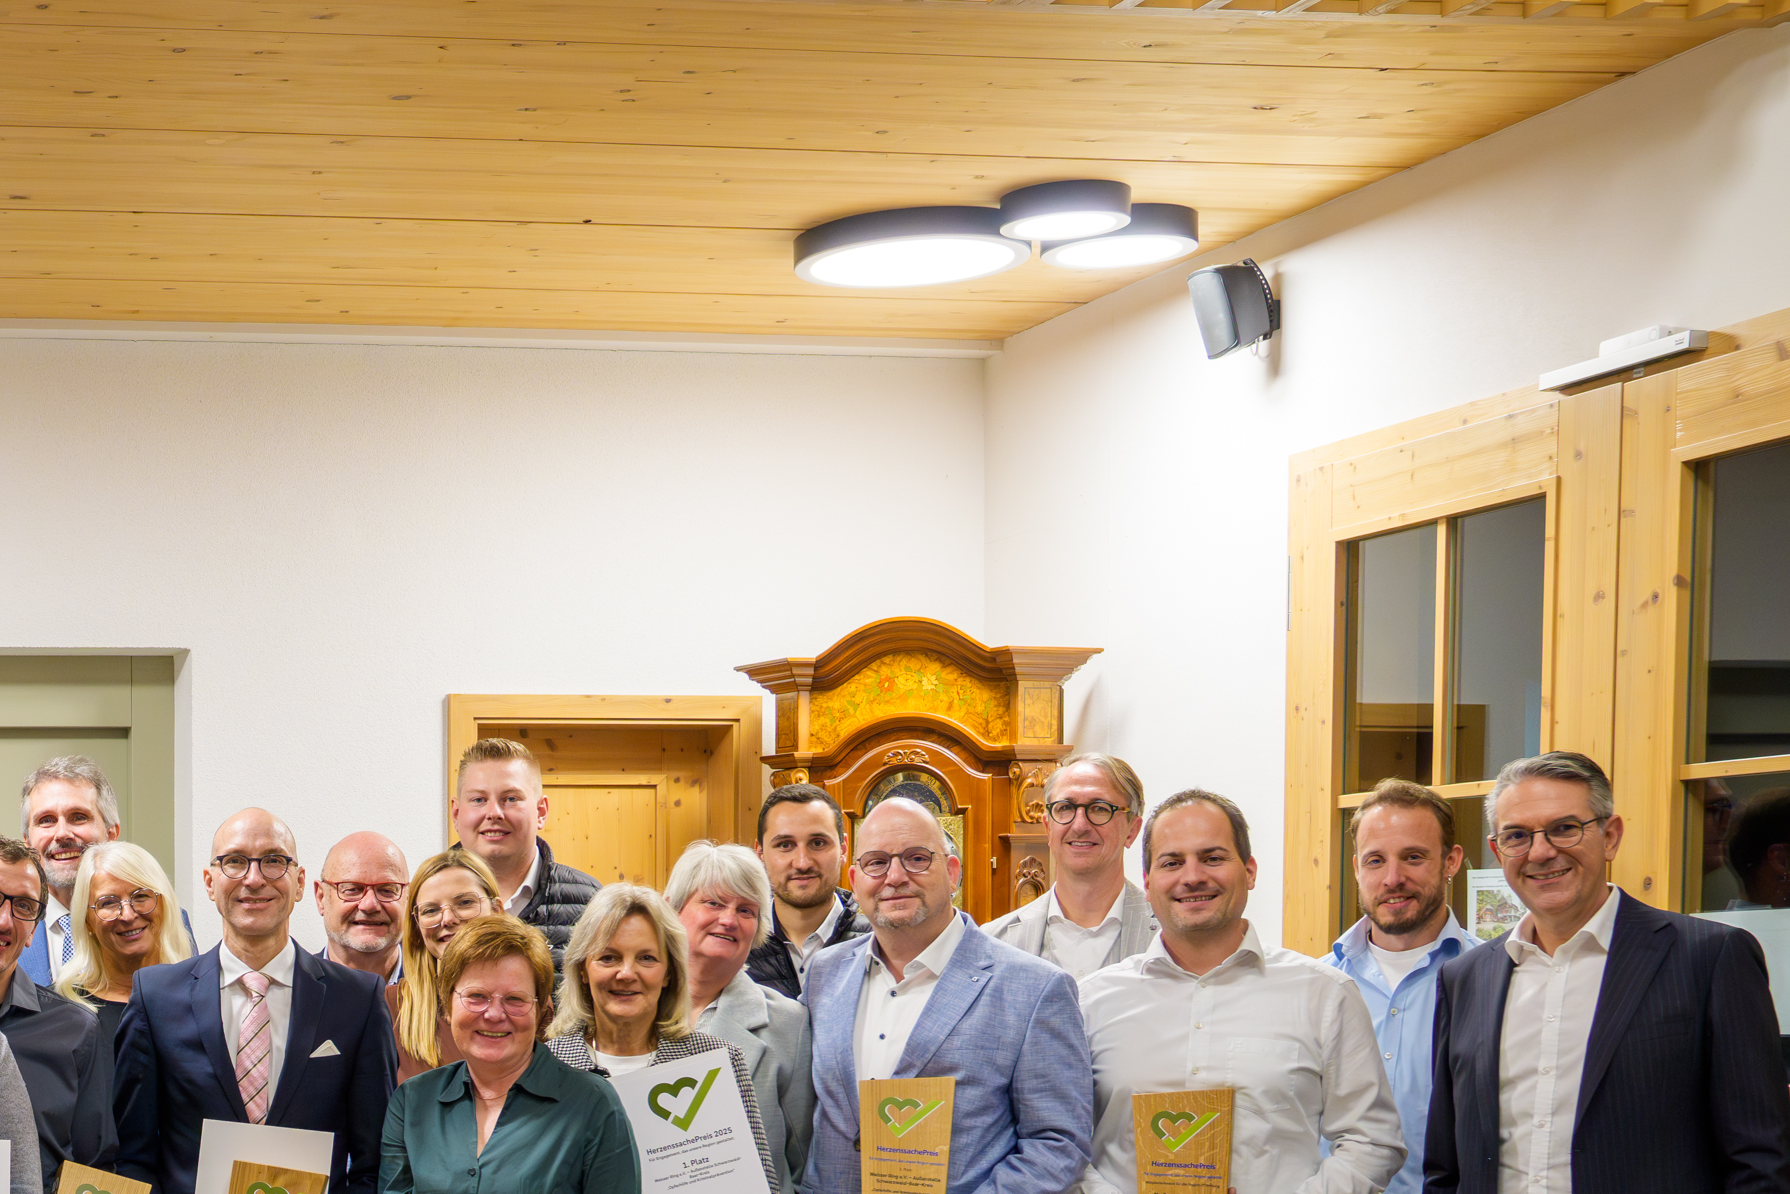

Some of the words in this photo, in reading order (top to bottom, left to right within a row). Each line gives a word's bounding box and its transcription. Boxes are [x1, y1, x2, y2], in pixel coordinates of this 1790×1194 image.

[646, 1132, 713, 1155] HerzenssachePreis
[713, 1126, 733, 1138] 2025
[876, 1145, 939, 1156] HerzenssachePreis
[682, 1161, 690, 1169] 1.
[690, 1157, 710, 1166] Platz
[1151, 1161, 1216, 1170] HerzenssachePreis
